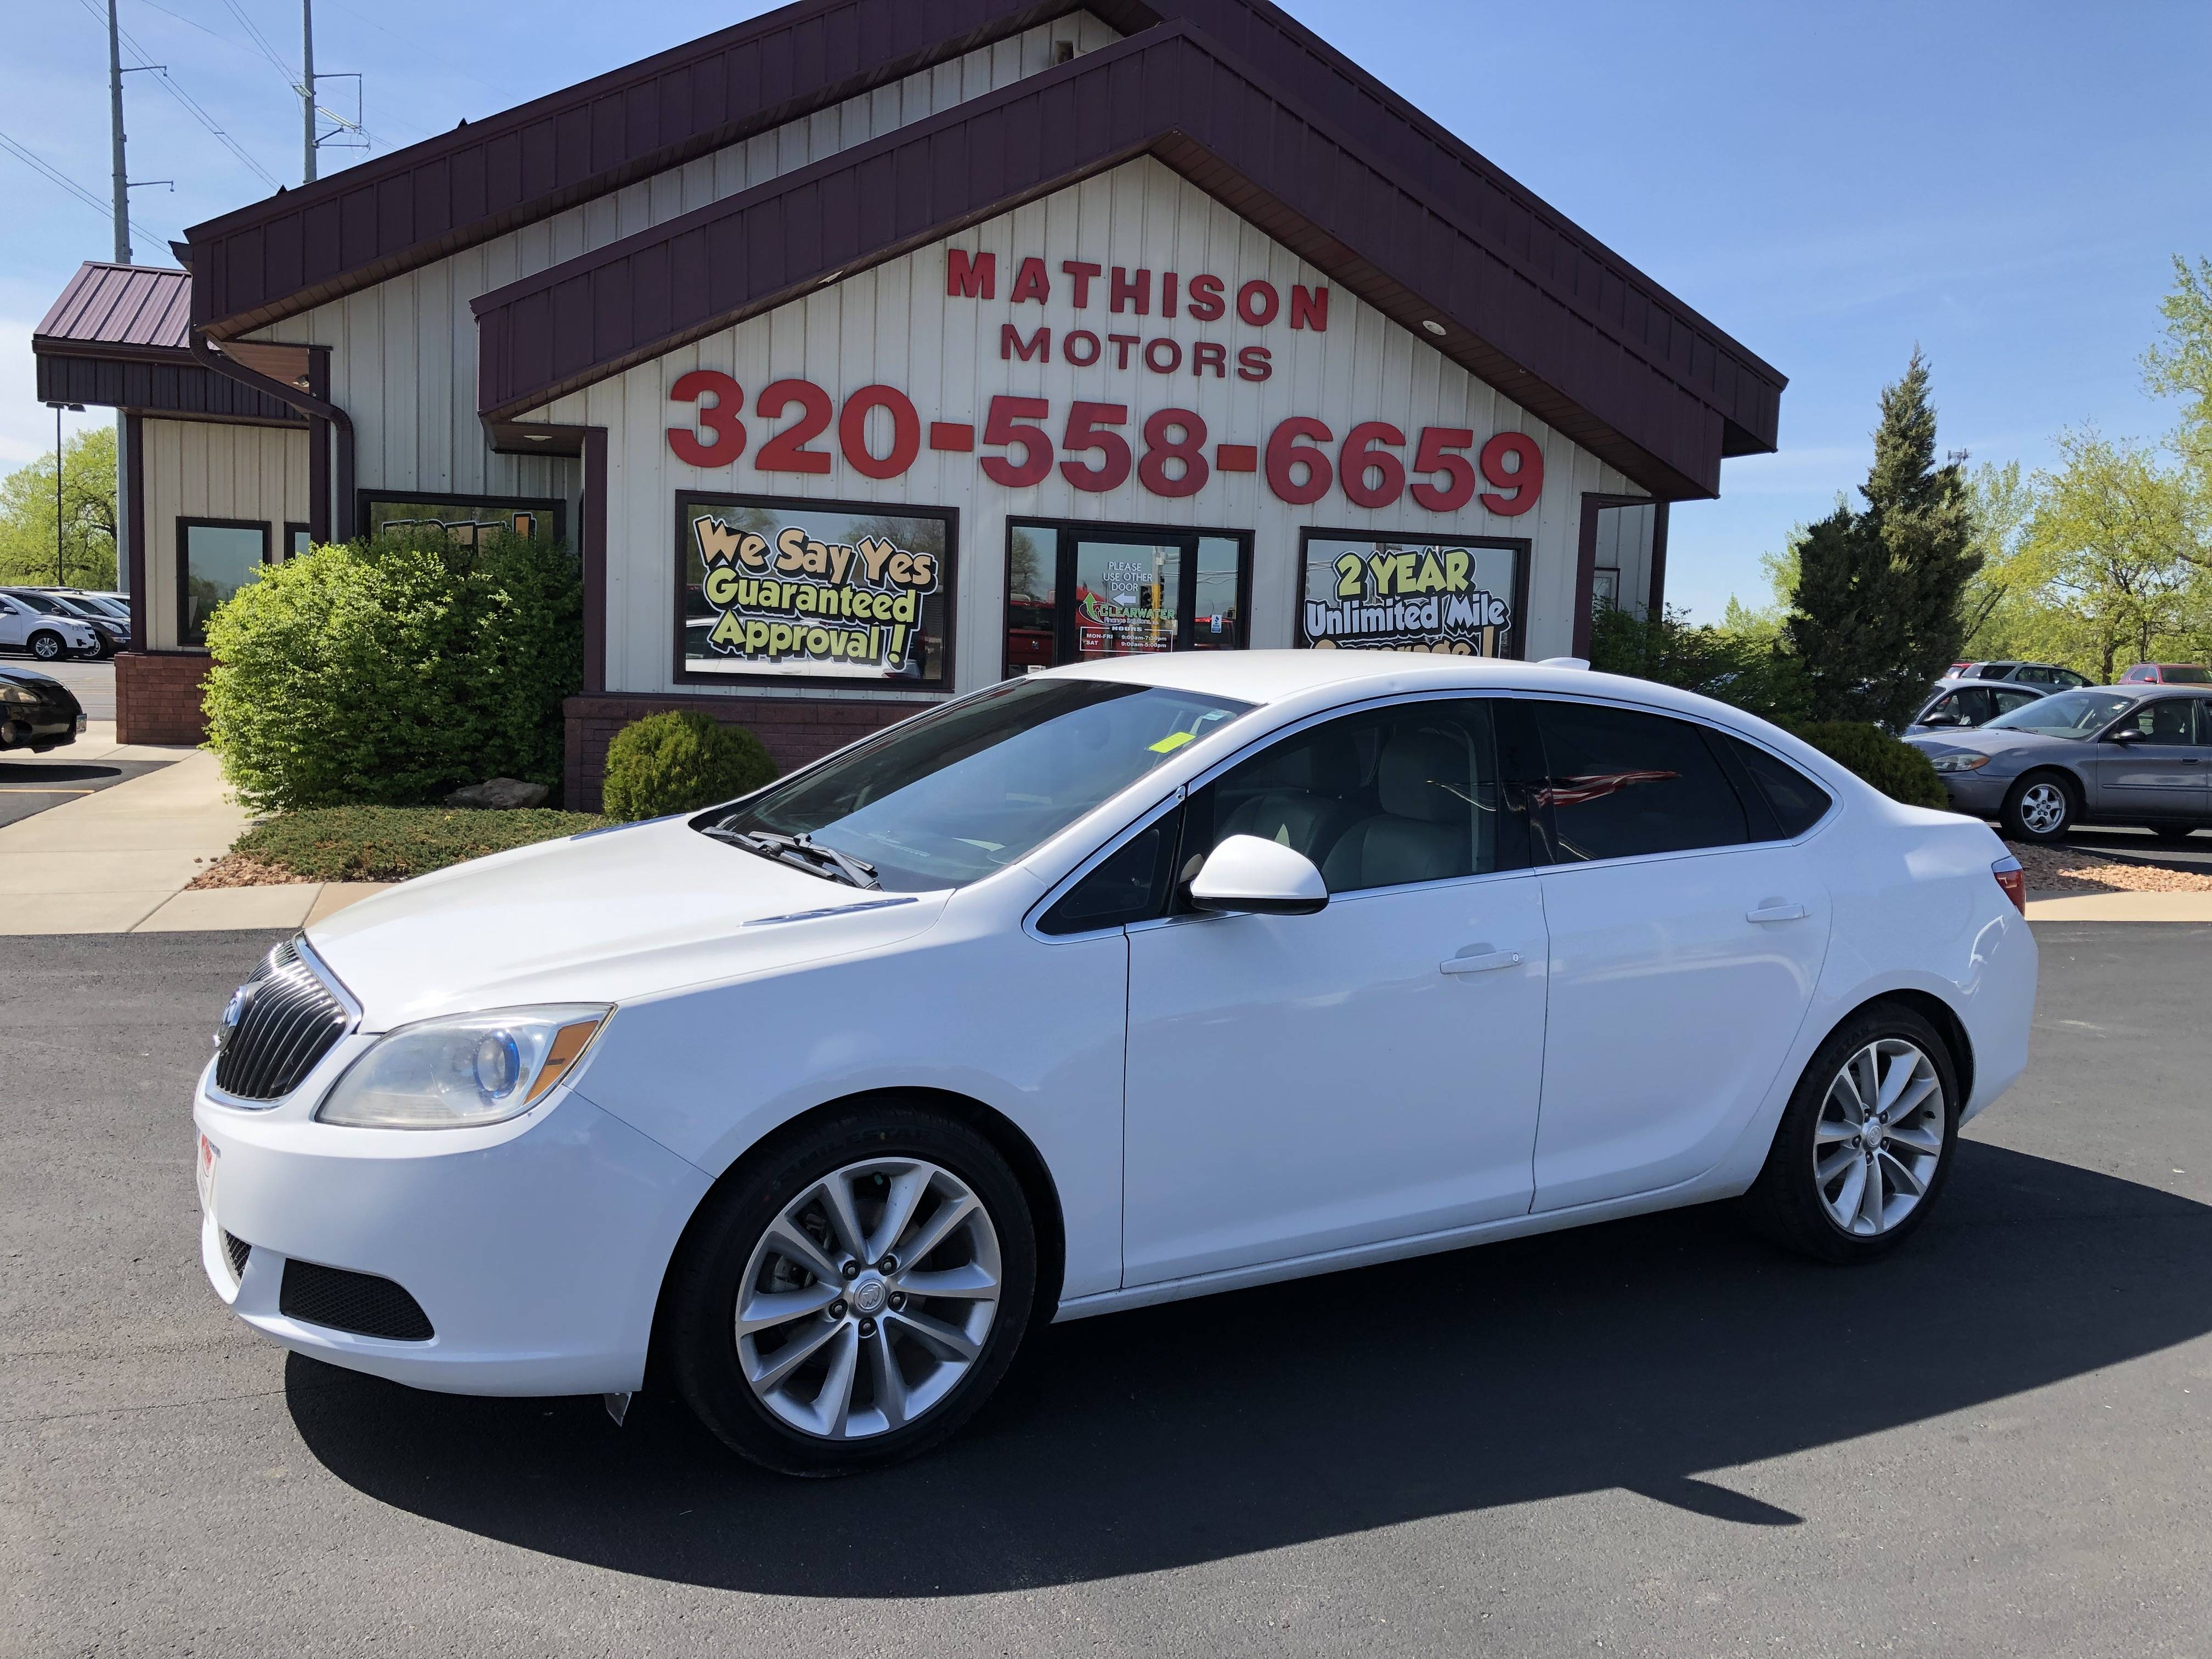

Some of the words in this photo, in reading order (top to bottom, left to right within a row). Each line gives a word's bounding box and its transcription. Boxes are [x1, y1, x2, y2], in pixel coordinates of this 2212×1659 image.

[947, 249, 1328, 332] MATHISON
[1001, 324, 1272, 382] MOTORS
[668, 370, 1544, 517] 320-558-6659
[696, 516, 767, 568] We
[775, 529, 853, 584] Say
[859, 537, 934, 586] Yes
[1108, 561, 1142, 572] PLEASE
[1336, 554, 1363, 597] 2
[1369, 548, 1470, 595] YEAR
[706, 567, 917, 624] Guaranteed
[1103, 572, 1120, 582] USE
[1123, 572, 1153, 582] OTHER
[1111, 583, 1138, 592] DOOR
[1099, 605, 1175, 619] CLEARWATER
[1306, 596, 1438, 636] Unlimited
[1446, 592, 1505, 629] Mile
